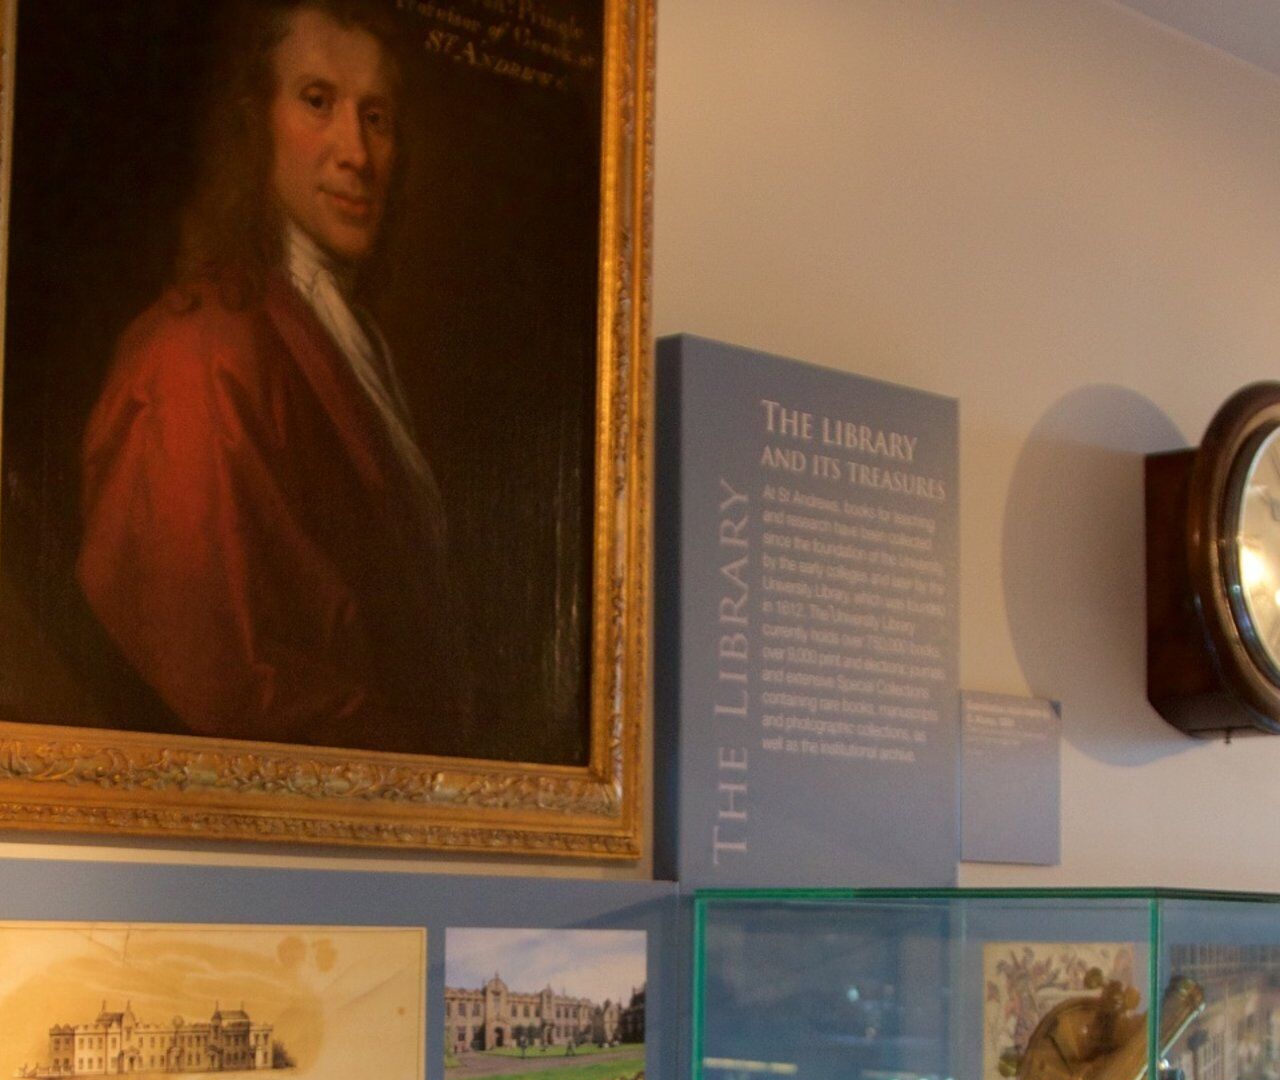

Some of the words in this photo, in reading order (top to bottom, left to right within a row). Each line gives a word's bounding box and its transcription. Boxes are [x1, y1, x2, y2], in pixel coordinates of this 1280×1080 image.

[761, 399, 813, 440] THE
[822, 416, 918, 463] LIBRARY
[761, 445, 807, 473] AND
[813, 454, 841, 481] ITS
[847, 461, 947, 501] TREASURES
[715, 478, 749, 717] LIBRARY
[713, 746, 748, 866] THE
